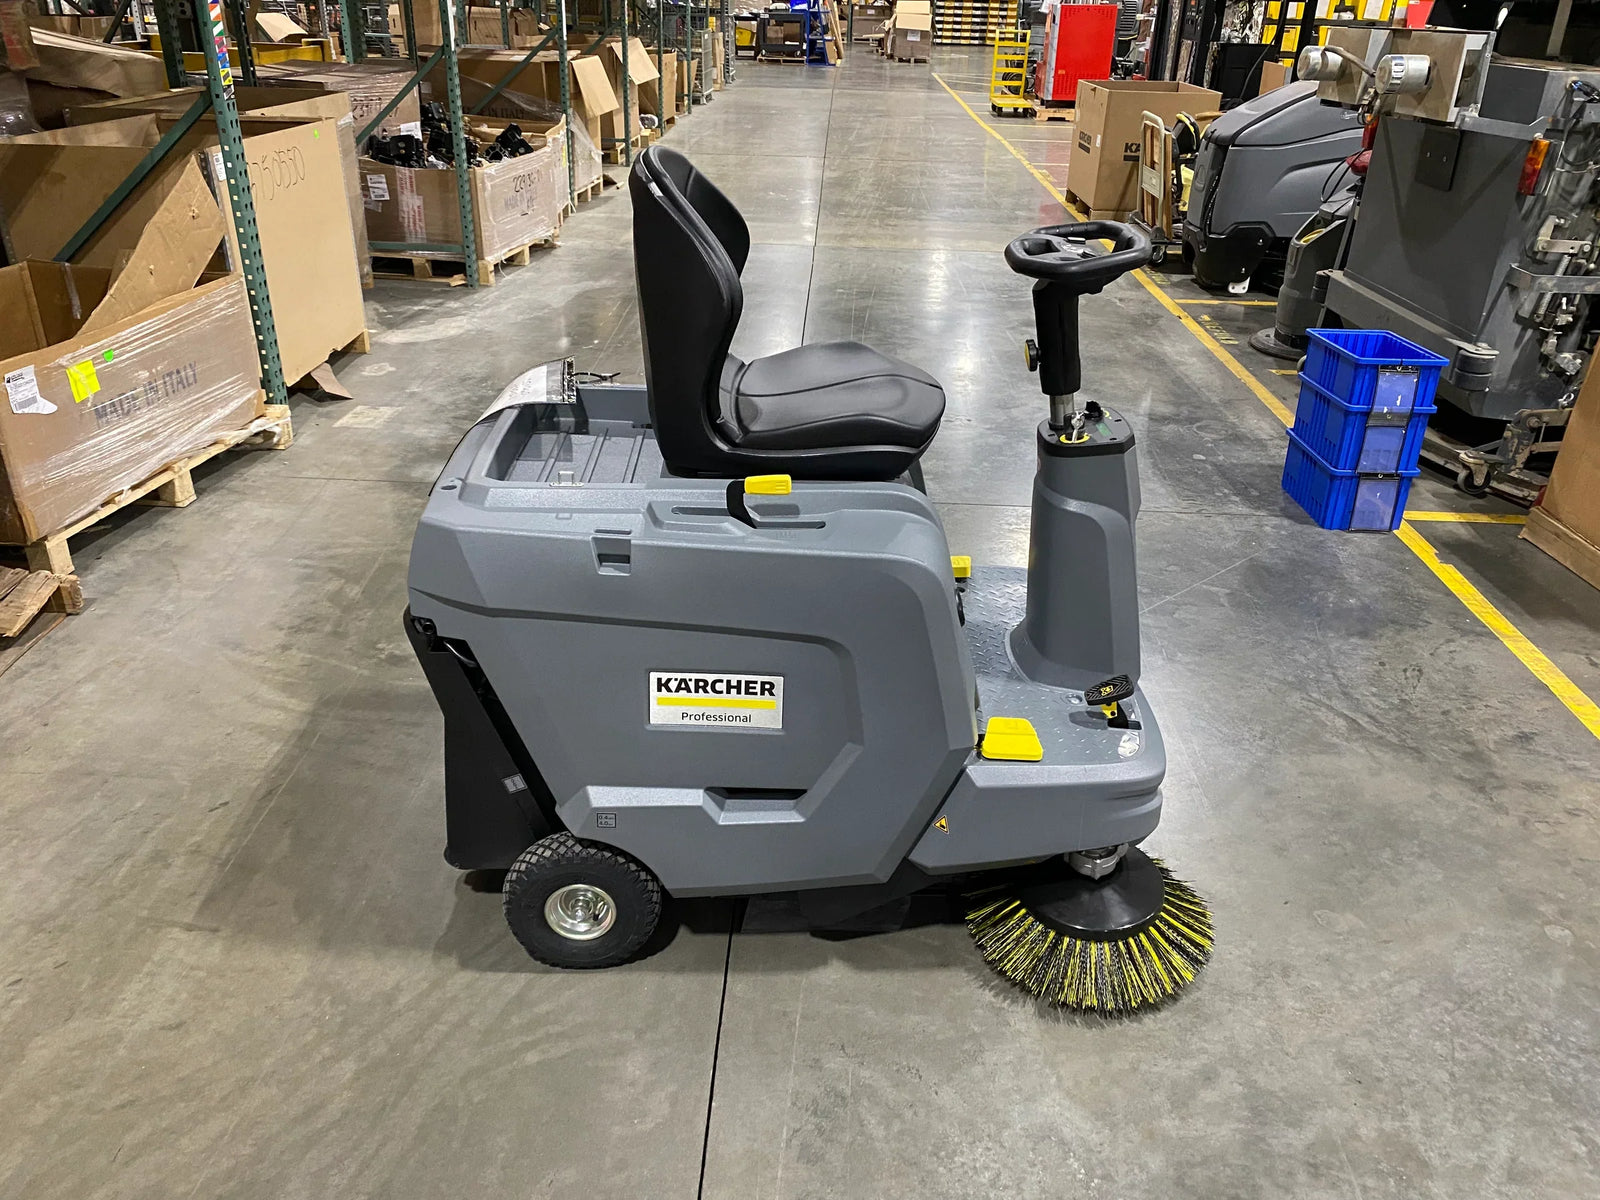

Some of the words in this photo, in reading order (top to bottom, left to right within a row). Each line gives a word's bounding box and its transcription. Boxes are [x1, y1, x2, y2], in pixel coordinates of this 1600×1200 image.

[161, 361, 199, 397] ITALY
[656, 677, 776, 697] KÄRCHER
[681, 711, 752, 723] Professional
